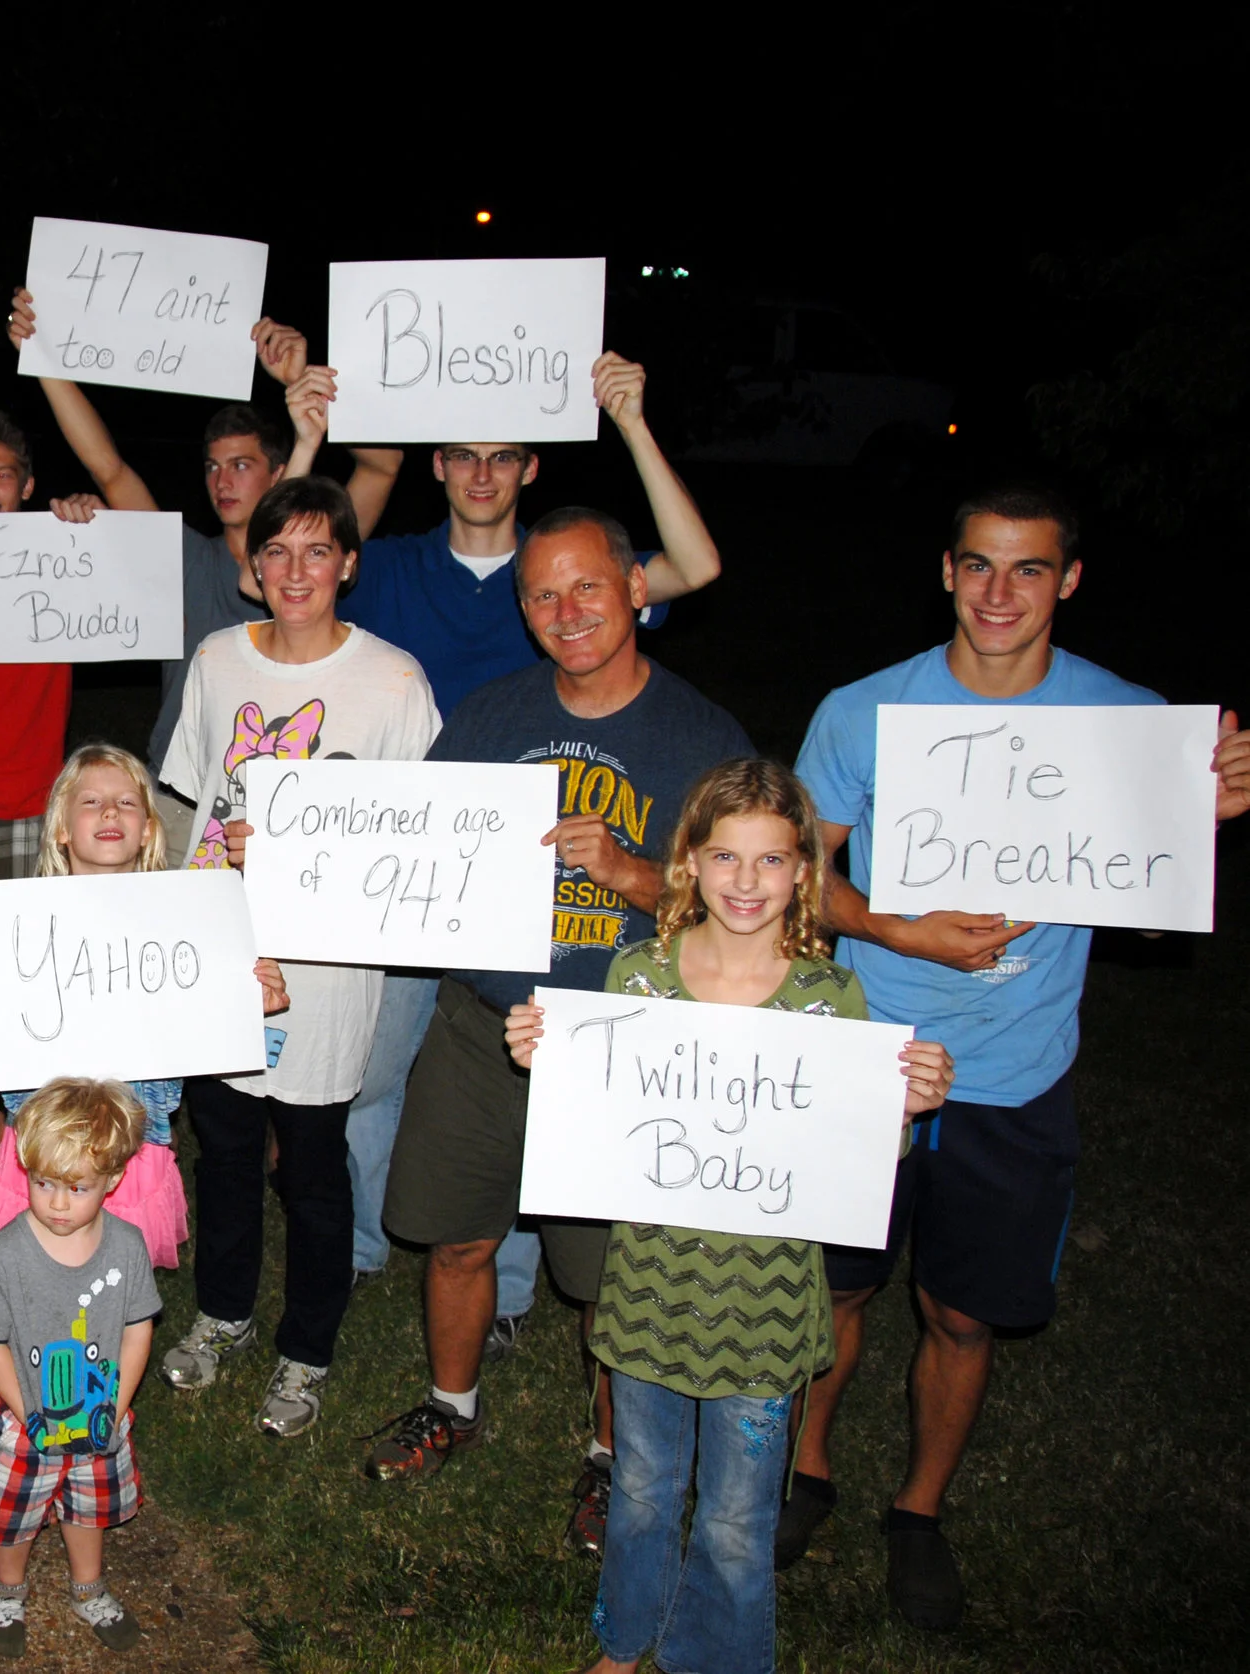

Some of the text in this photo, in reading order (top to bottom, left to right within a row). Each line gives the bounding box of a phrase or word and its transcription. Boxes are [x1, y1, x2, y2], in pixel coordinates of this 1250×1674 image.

[67, 245, 230, 324] 47 aint
[56, 326, 187, 376] too old
[366, 289, 569, 415] Blessing
[13, 591, 140, 648] Buddy
[550, 740, 598, 761] WHEN
[927, 721, 1068, 800] Tie
[266, 771, 506, 858] Combined age
[895, 808, 1174, 890] Breaker
[300, 851, 475, 934] of 94!
[553, 913, 611, 944] HANGE
[567, 1008, 812, 1135] Twilight
[626, 1118, 794, 1215] Baby
